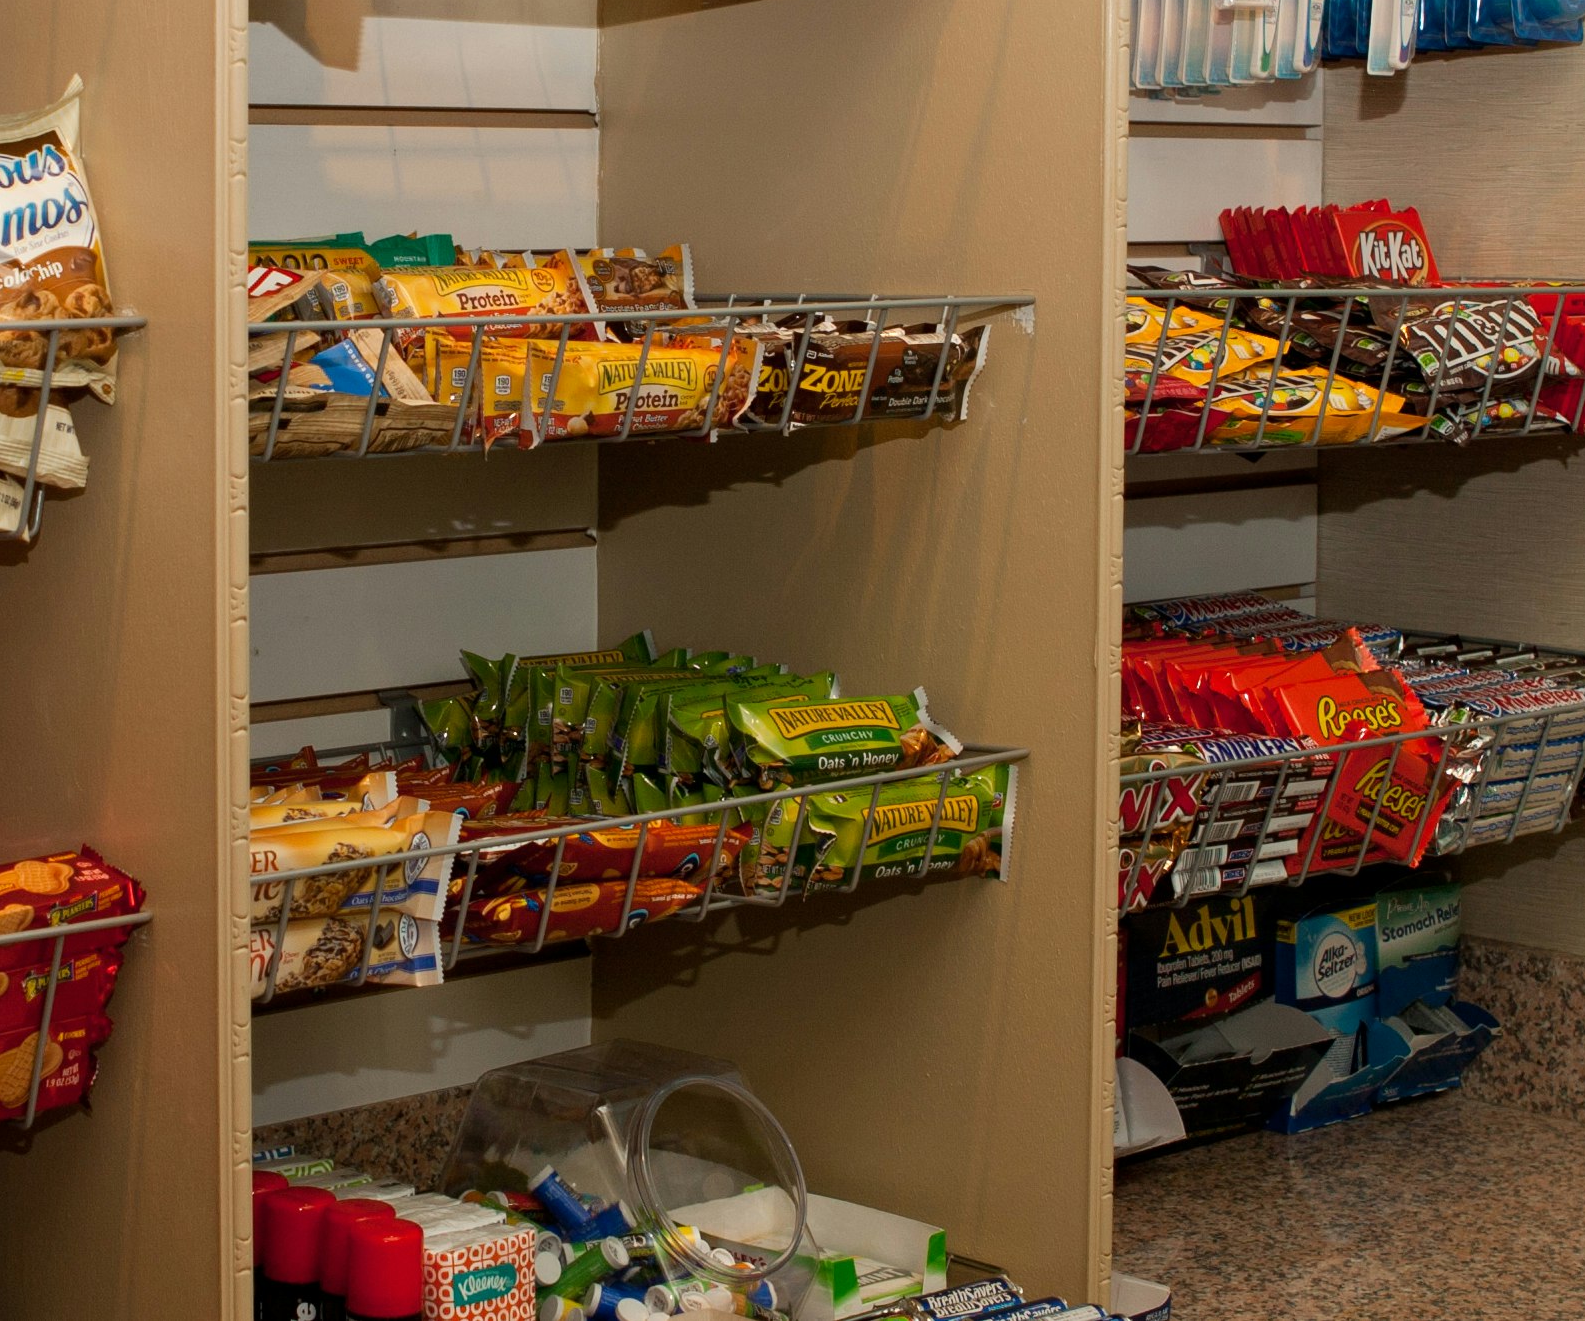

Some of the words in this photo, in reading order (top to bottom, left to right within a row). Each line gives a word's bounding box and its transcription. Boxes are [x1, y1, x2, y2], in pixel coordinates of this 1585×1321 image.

[456, 289, 520, 311] Protein
[650, 361, 695, 384] VALLEY
[799, 362, 868, 393] ZONE
[613, 389, 680, 412] Potein
[776, 707, 833, 736] NATURE
[832, 702, 894, 726] VALLEY
[1317, 694, 1402, 740] Reese's
[821, 730, 874, 745] CRUNCHY
[818, 755, 846, 771] Oats
[849, 754, 859, 768] 'n
[863, 751, 900, 769] Honey
[874, 864, 903, 879] Oats
[1158, 894, 1257, 959] Advil
[1381, 914, 1435, 944] Stomach
[1317, 952, 1357, 982] Seltzer
[1320, 944, 1349, 965] Alka-
[1228, 979, 1256, 1005] Tablets
[457, 1271, 509, 1301] Kleenex
